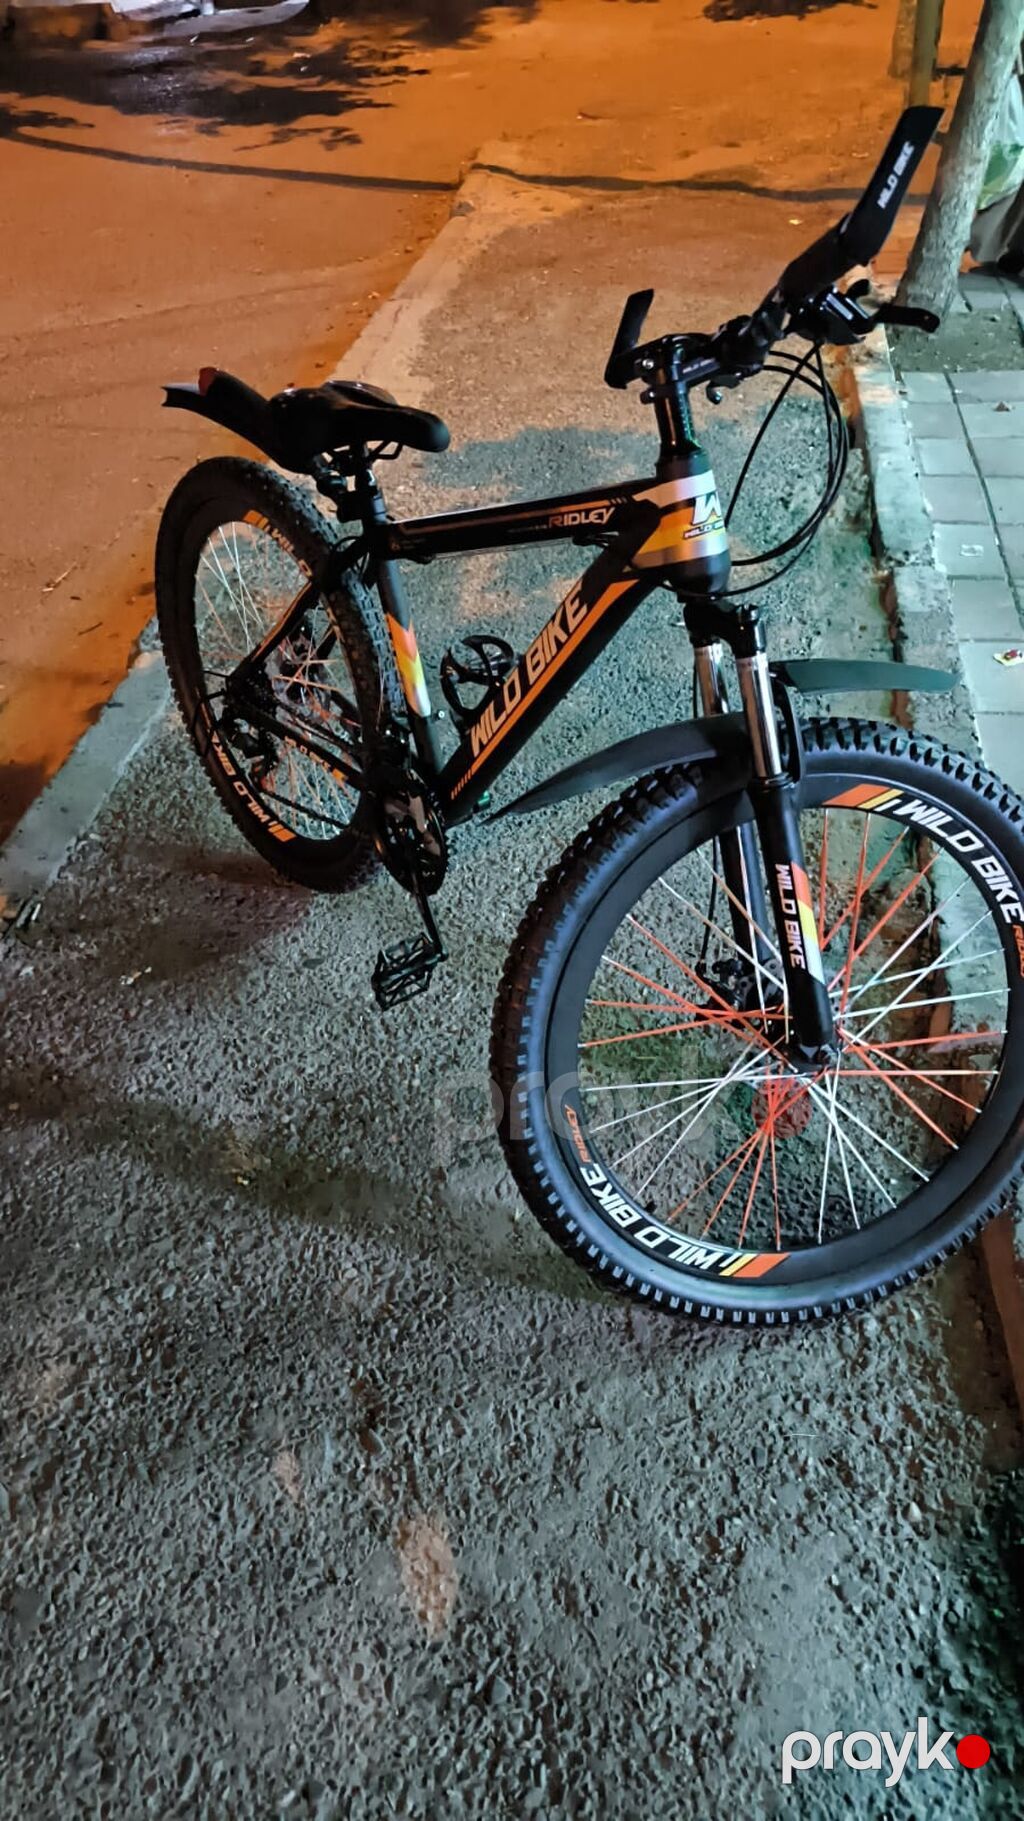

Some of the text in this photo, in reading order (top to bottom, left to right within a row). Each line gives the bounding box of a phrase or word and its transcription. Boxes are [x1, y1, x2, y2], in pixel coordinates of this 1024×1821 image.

[876, 141, 915, 209] WILD BIKE
[549, 507, 615, 529] RIDLEY
[470, 668, 522, 758] WILD
[524, 580, 588, 686] BIKE
[233, 780, 271, 823] WILD
[892, 798, 985, 853] WILD
[970, 854, 1024, 923] BIKE
[775, 863, 806, 970] WILD BIKE
[564, 1103, 725, 1271] WILD BIKE RIDLEY
